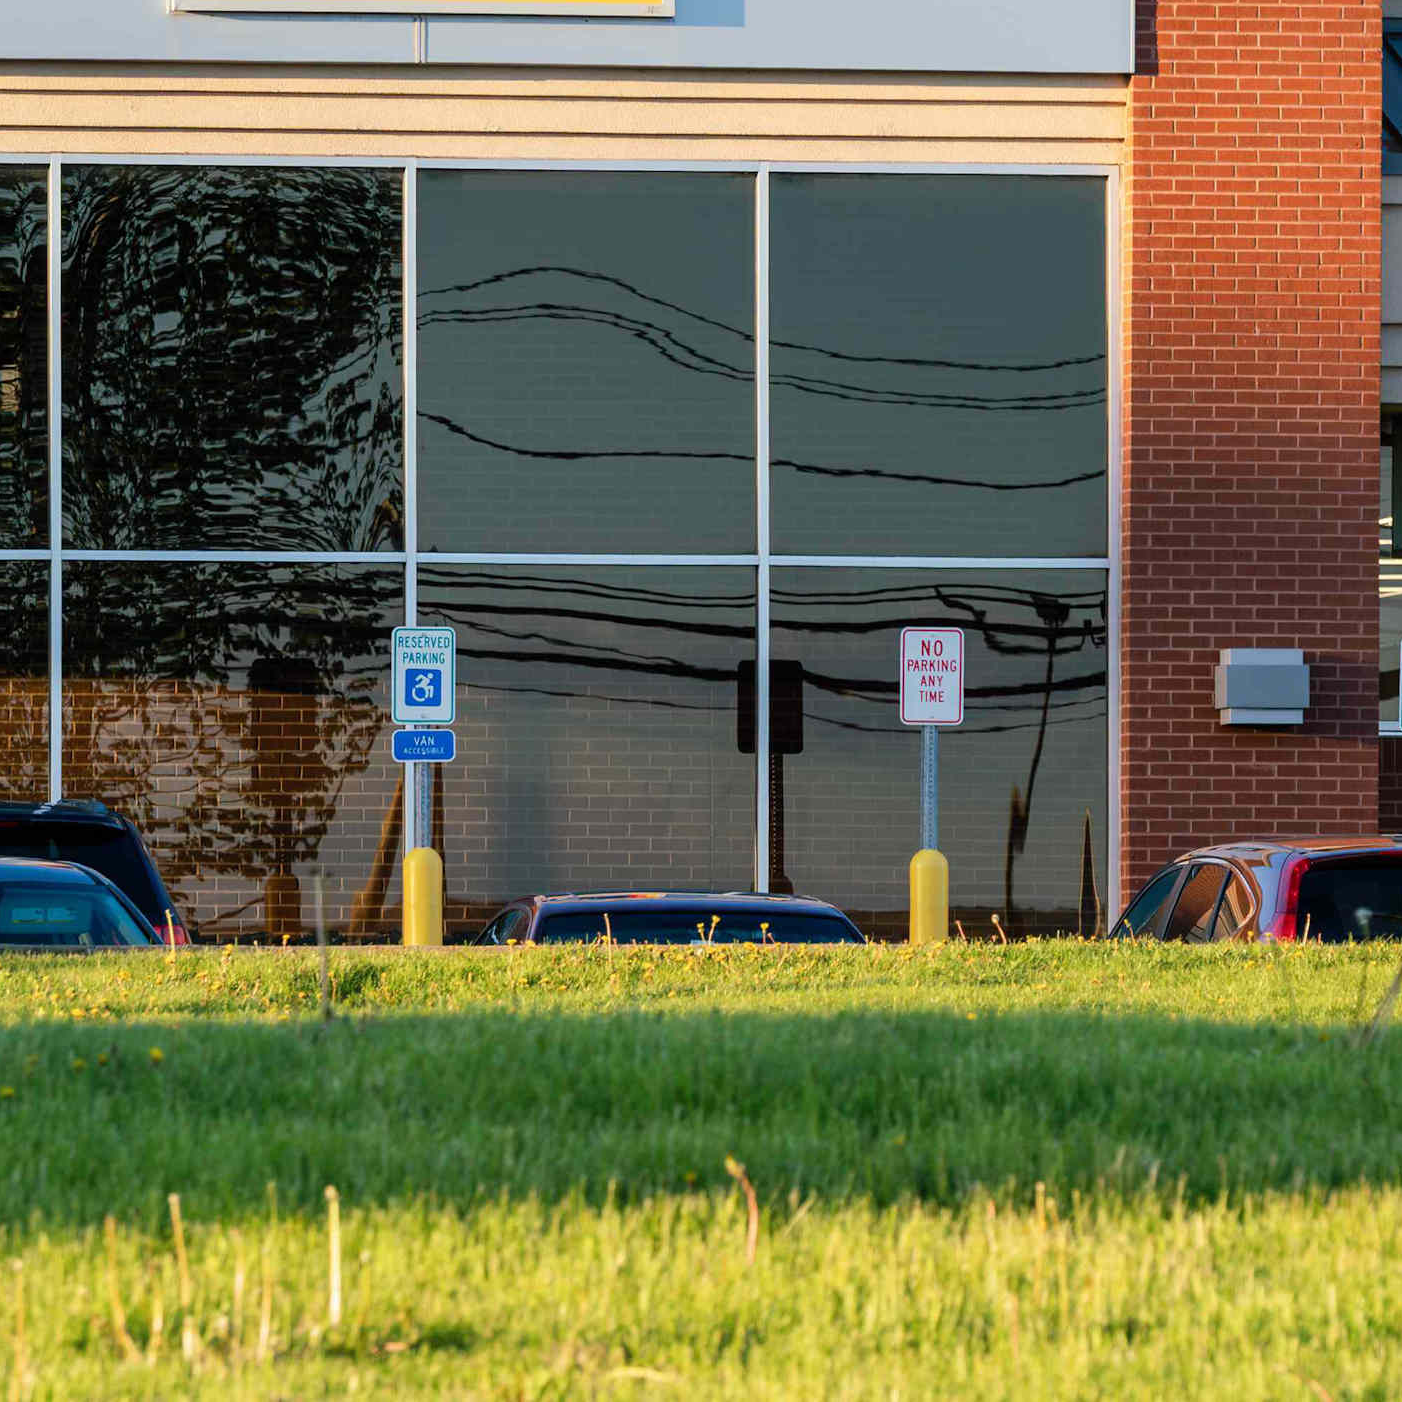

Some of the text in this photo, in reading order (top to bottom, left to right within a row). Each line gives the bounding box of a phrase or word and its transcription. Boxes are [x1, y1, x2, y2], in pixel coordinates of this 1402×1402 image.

[398, 636, 450, 649] RESERVED
[920, 639, 944, 657] NO
[402, 652, 446, 665] PARKING
[907, 659, 958, 673] PARKING
[920, 675, 944, 687] ANY
[919, 690, 945, 703] TIME
[413, 735, 436, 747] VAN
